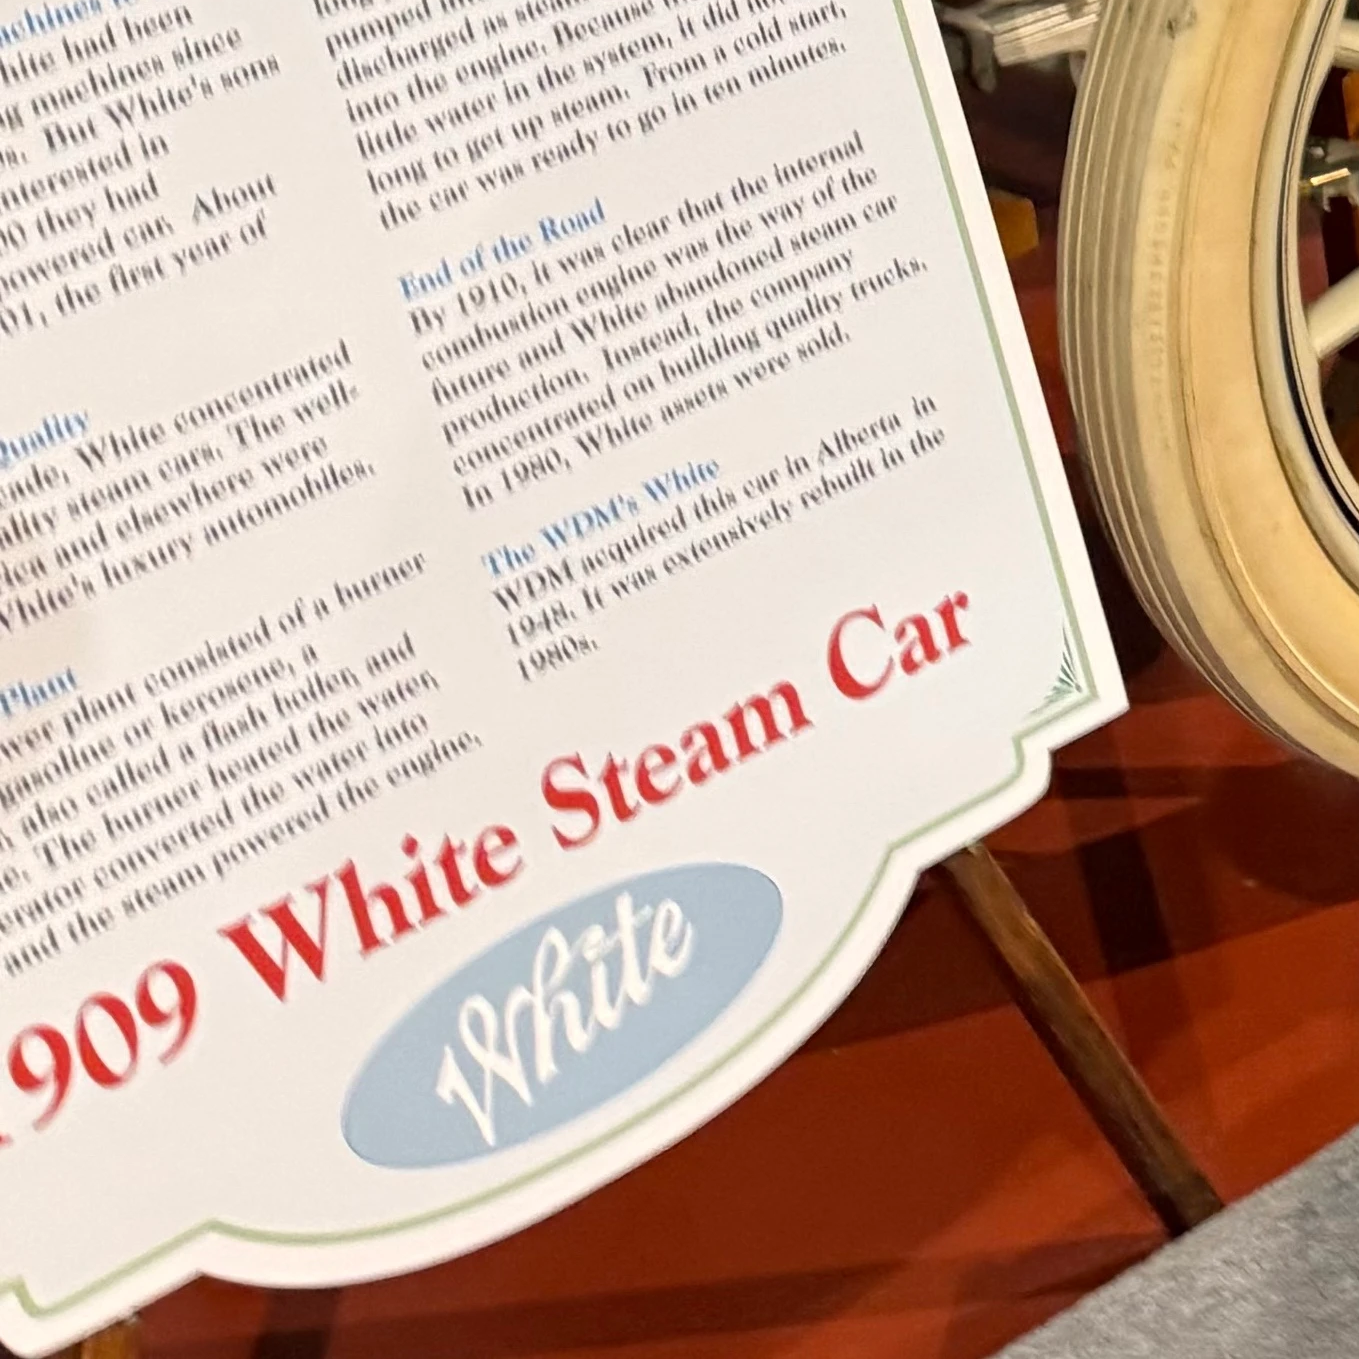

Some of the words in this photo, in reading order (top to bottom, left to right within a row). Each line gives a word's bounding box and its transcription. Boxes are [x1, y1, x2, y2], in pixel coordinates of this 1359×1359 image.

[336, 15, 477, 90] discharged
[482, 14, 509, 40] as
[345, 91, 401, 124] into
[406, 72, 448, 105] the
[355, 119, 418, 161] little
[424, 92, 498, 135] water
[501, 79, 531, 106] in
[535, 63, 577, 94] the
[676, 14, 697, 41] it
[366, 157, 429, 196] long
[432, 146, 460, 173] to
[465, 126, 505, 165] get
[510, 114, 545, 142] up
[641, 52, 709, 90] From
[712, 44, 728, 66] a
[732, 14, 784, 57] cold
[379, 199, 422, 231] the
[428, 180, 469, 212] car
[475, 162, 525, 193] was
[530, 127, 599, 173] ready
[605, 119, 632, 143] to
[636, 105, 667, 136] go
[671, 90, 699, 117] in
[703, 75, 742, 105] ten
[408, 306, 446, 336] By
[456, 271, 528, 318] 1910,
[531, 260, 552, 287] it
[556, 244, 607, 275] was
[610, 214, 671, 255] clear
[677, 191, 725, 228] that
[730, 175, 769, 206] the
[772, 129, 865, 188] internal
[399, 258, 453, 301] End
[459, 243, 486, 277] of
[492, 234, 533, 265] the
[538, 197, 606, 246] Road
[421, 295, 571, 372] combustion
[575, 259, 658, 307] engine
[662, 237, 710, 270] was
[714, 218, 753, 249] the
[757, 195, 805, 230] way
[811, 175, 836, 209] of
[840, 167, 878, 196] the
[431, 358, 511, 407] future
[517, 327, 567, 372] and
[567, 300, 648, 346] White
[654, 235, 786, 314] abandoned
[789, 212, 858, 256] steam
[862, 194, 897, 223] car
[705, 297, 744, 329] the
[749, 248, 853, 309] company
[73, 422, 166, 473] White
[173, 338, 352, 435] concentrated
[452, 381, 618, 477] concentrated
[622, 373, 657, 402] on
[658, 326, 762, 385] building
[764, 290, 843, 342] quality
[461, 484, 494, 511] In
[500, 446, 572, 494] 1980,
[572, 412, 653, 459] White
[659, 379, 729, 426] assets
[732, 351, 791, 390] were
[99, 532, 193, 589] luxury
[482, 543, 536, 577] The
[642, 460, 720, 504] White
[492, 557, 576, 614] WDM
[580, 503, 688, 577] acquired
[692, 486, 738, 524] this
[742, 468, 780, 500] car
[784, 454, 812, 480] in
[817, 413, 902, 467] Alberta
[911, 395, 938, 419] in
[507, 600, 578, 648] 1948.
[580, 586, 605, 614] It
[608, 565, 658, 600] was
[662, 498, 793, 576] extensively
[799, 456, 877, 510] rebuilt
[878, 446, 906, 471] in
[909, 428, 945, 458] the
[517, 634, 599, 682] 1980s.
[0, 959, 199, 1147] 909
[219, 833, 523, 1002] White
[540, 679, 813, 851] Steam
[826, 590, 971, 703] Car
[3, 924, 61, 977] and
[66, 906, 115, 945] the
[121, 863, 207, 918] steam
[211, 794, 331, 880] powered
[336, 777, 380, 812] the
[435, 890, 695, 1148] White
